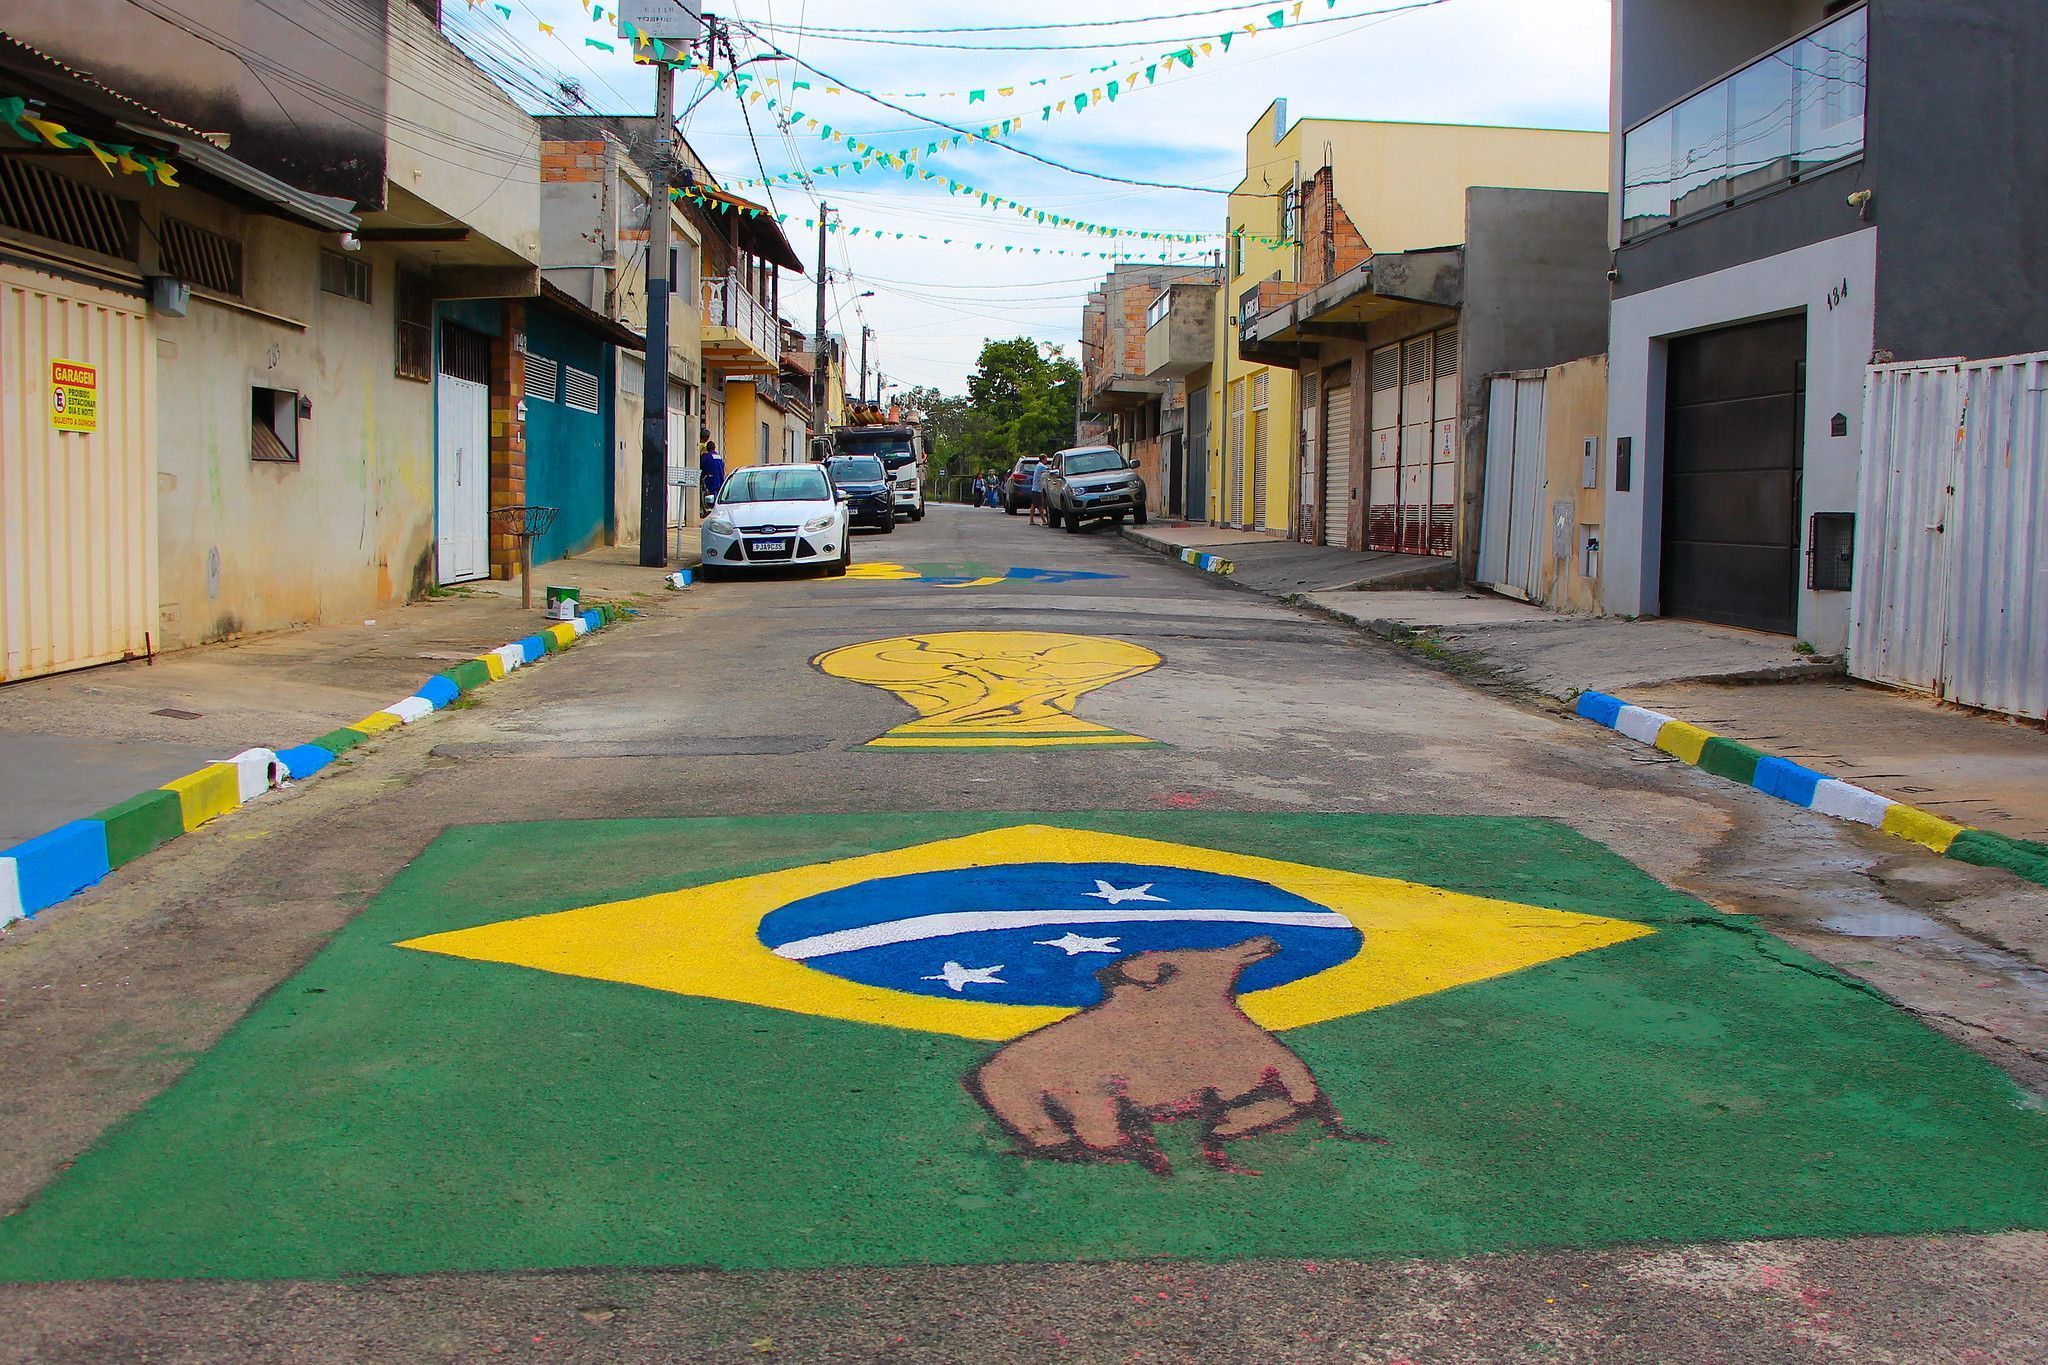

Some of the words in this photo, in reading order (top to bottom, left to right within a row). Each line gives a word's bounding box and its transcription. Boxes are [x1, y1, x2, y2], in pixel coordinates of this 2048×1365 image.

[1827, 277, 1847, 311] 184
[55, 366, 95, 385] GARAGEM
[68, 388, 90, 398] PROIBIDO
[68, 397, 96, 408] ESTACIONAR
[82, 408, 94, 416] NOITE
[54, 416, 73, 425] SUJEITO
[78, 419, 96, 427] GUINCHO
